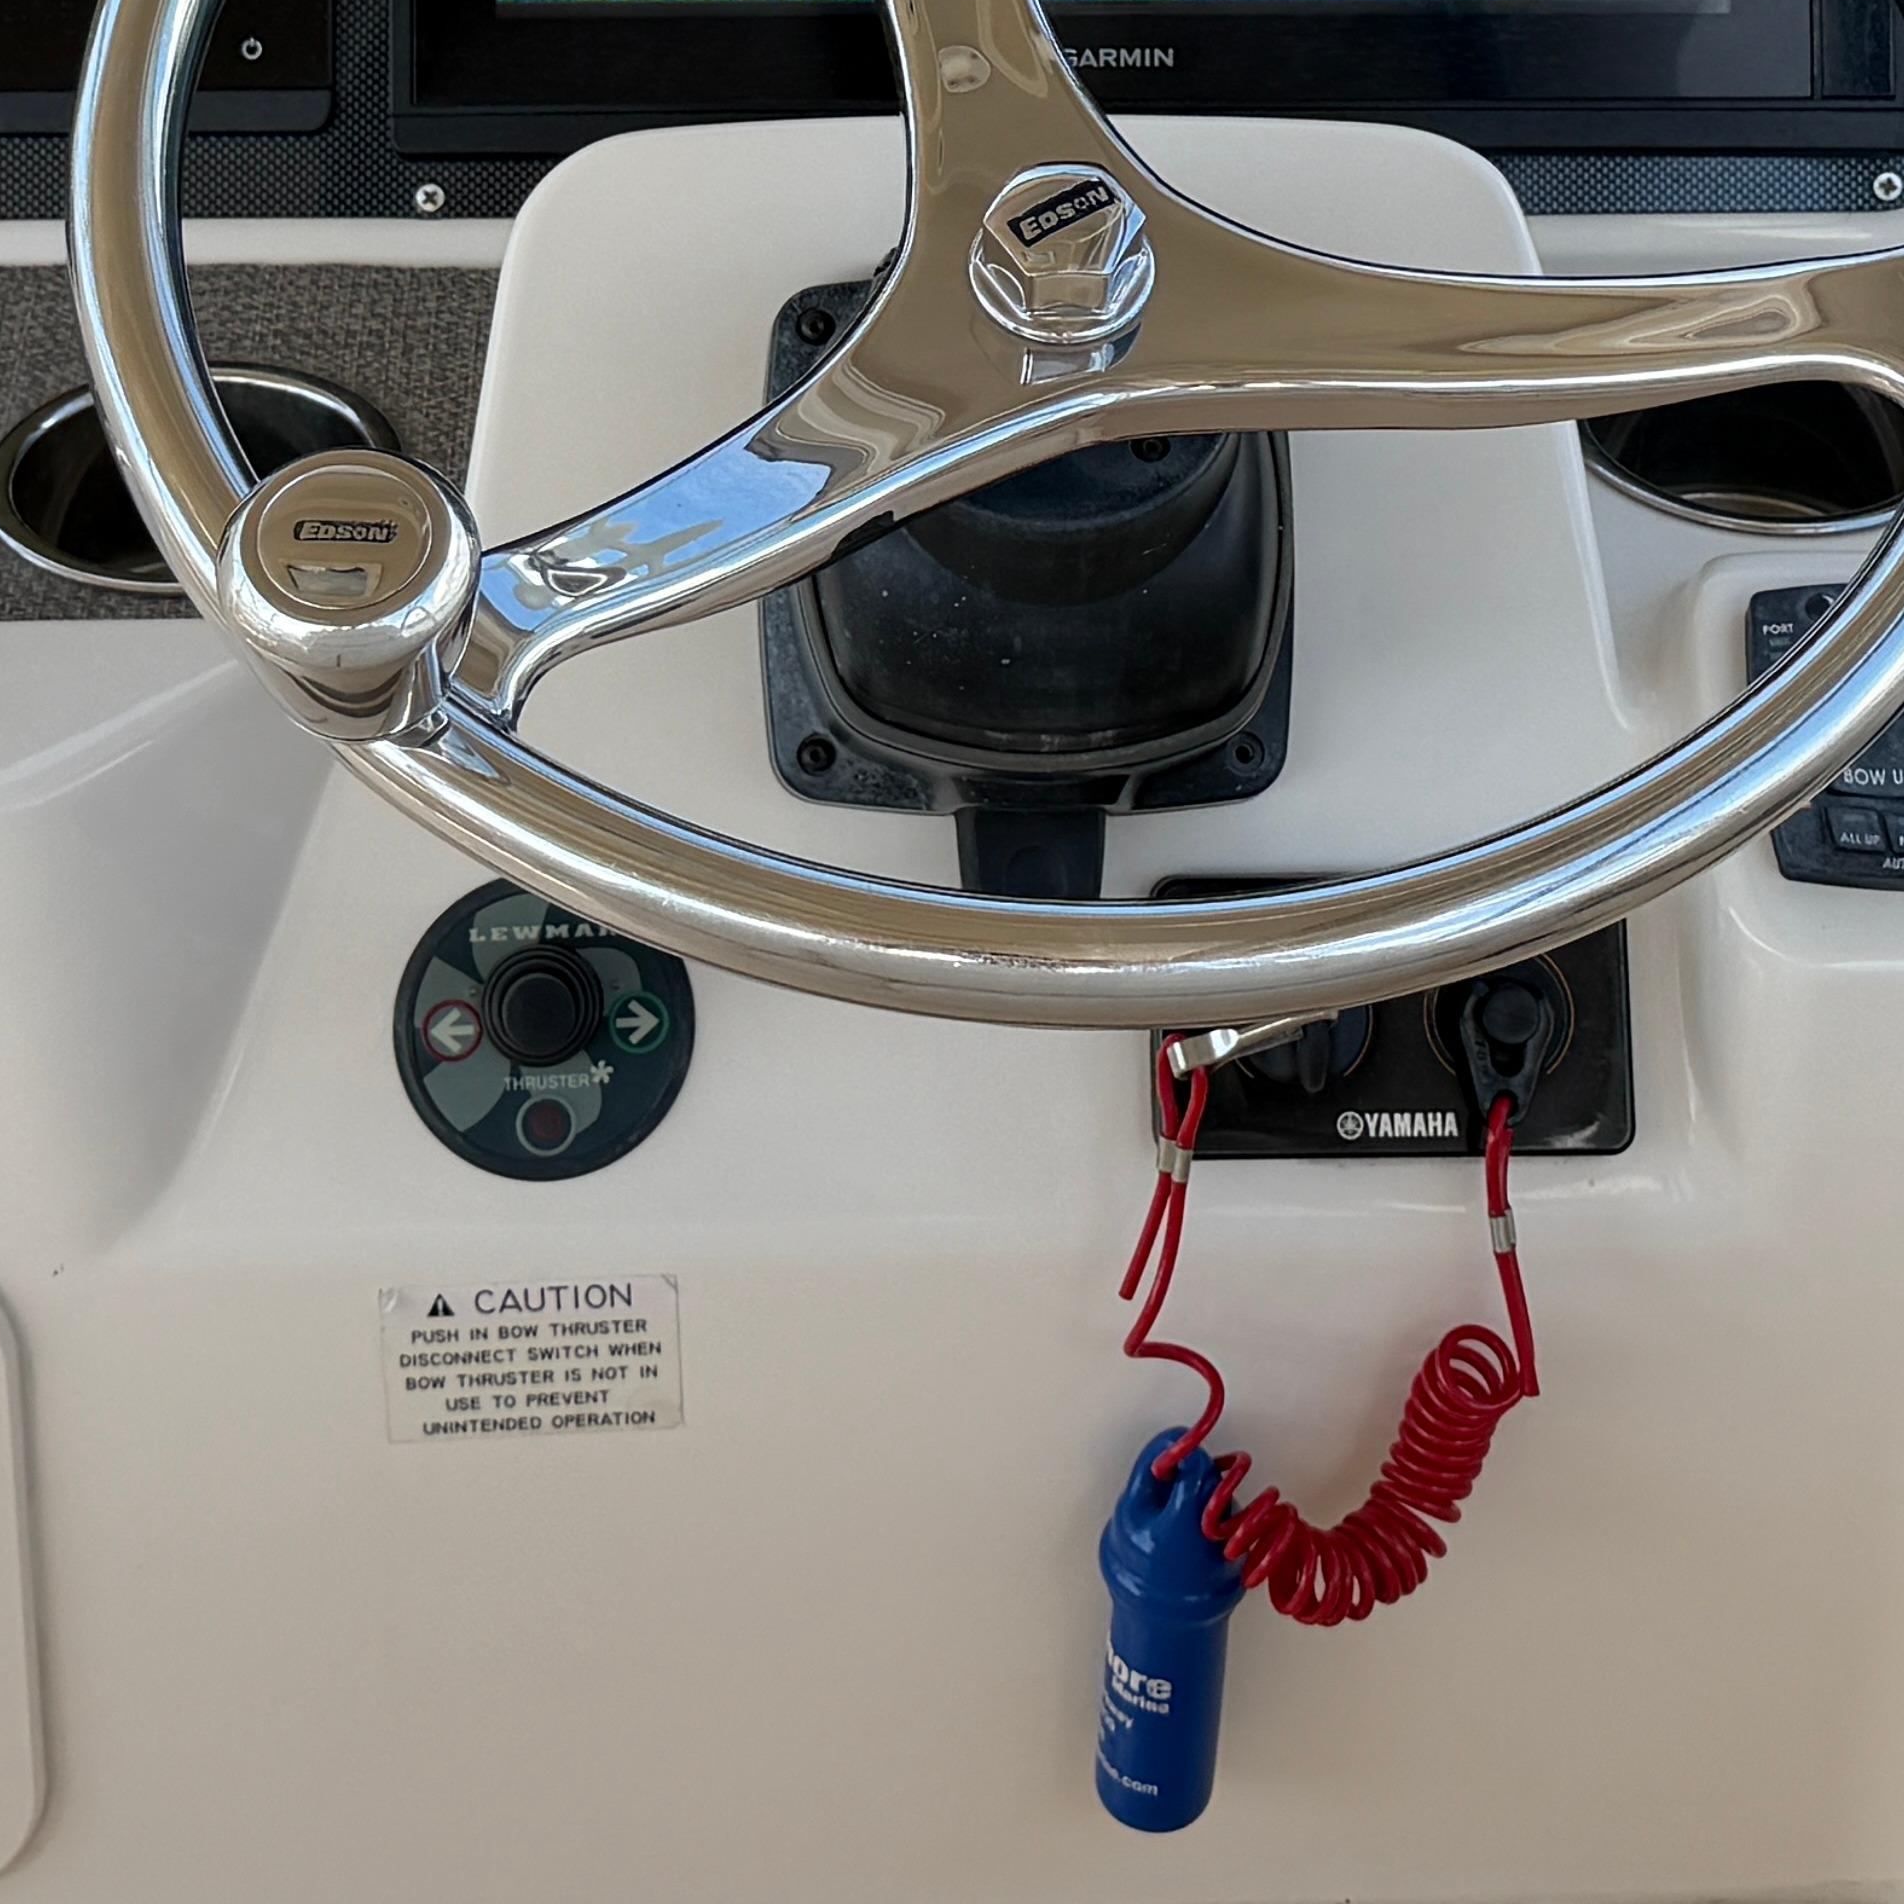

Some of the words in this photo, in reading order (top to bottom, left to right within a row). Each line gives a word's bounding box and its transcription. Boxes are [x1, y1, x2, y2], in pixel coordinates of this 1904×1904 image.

[1062, 49, 1175, 68] GARMIN
[1019, 185, 1110, 241] EDSON
[299, 520, 391, 541] EDSON
[1762, 623, 1794, 636] PORT
[1843, 767, 1886, 785] BOW
[1840, 832, 1862, 845] ALL
[504, 1073, 591, 1091] THRUSTER
[1365, 1111, 1459, 1138] YAMAHA
[474, 1283, 633, 1315] CAUTION
[411, 1328, 459, 1345] PUSH
[470, 1327, 489, 1341] IN
[499, 1324, 539, 1340] BOW
[550, 1318, 648, 1337] THRUSTER
[399, 1348, 516, 1369] DISCONNECT
[528, 1344, 599, 1361] SWITCH
[609, 1341, 662, 1357] WHEN
[405, 1375, 446, 1392] BOW
[458, 1369, 554, 1388] THRUSTER
[564, 1368, 582, 1383] IS
[591, 1366, 628, 1382] NOT
[640, 1364, 658, 1379] IN
[446, 1396, 481, 1412] USE
[493, 1393, 517, 1408] TO
[526, 1390, 609, 1407] PREVENT
[422, 1415, 542, 1436] UNINTENDED
[551, 1411, 656, 1429] OPERATION
